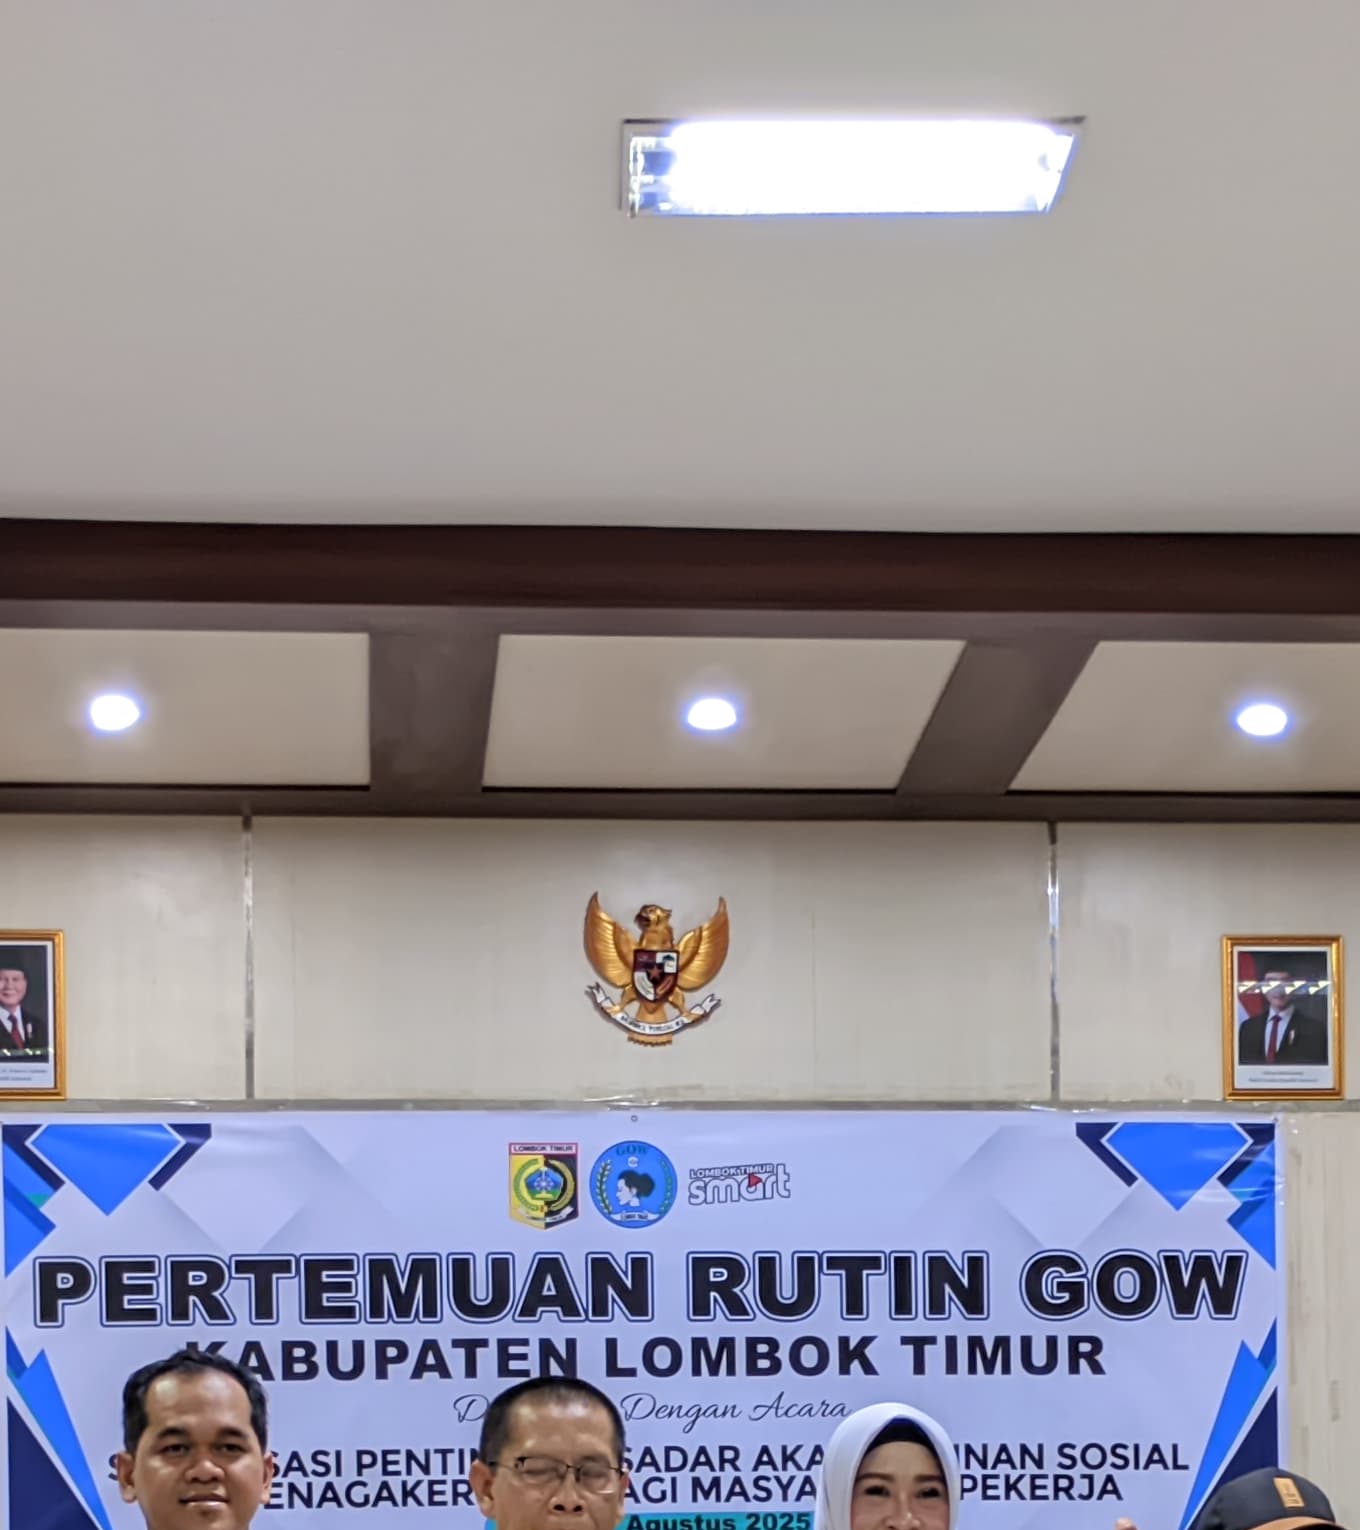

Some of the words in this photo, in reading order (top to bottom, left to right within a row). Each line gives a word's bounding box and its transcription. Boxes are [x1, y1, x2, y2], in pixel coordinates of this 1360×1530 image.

[688, 1163, 791, 1206] smart
[689, 1166, 738, 1179] LOMBOK
[739, 1163, 774, 1175] TIMUR
[34, 1251, 654, 1327] PERTEMUAN
[687, 1249, 991, 1322] RUTIN
[1019, 1248, 1248, 1322] GOW
[605, 1335, 880, 1379] LOMBOK
[900, 1334, 1107, 1376] TIMUR
[620, 1392, 742, 1434] Dengan
[748, 1391, 850, 1422] Acara
[1057, 1442, 1189, 1471] SOSIAL
[960, 1473, 1124, 1501] PEKERJA
